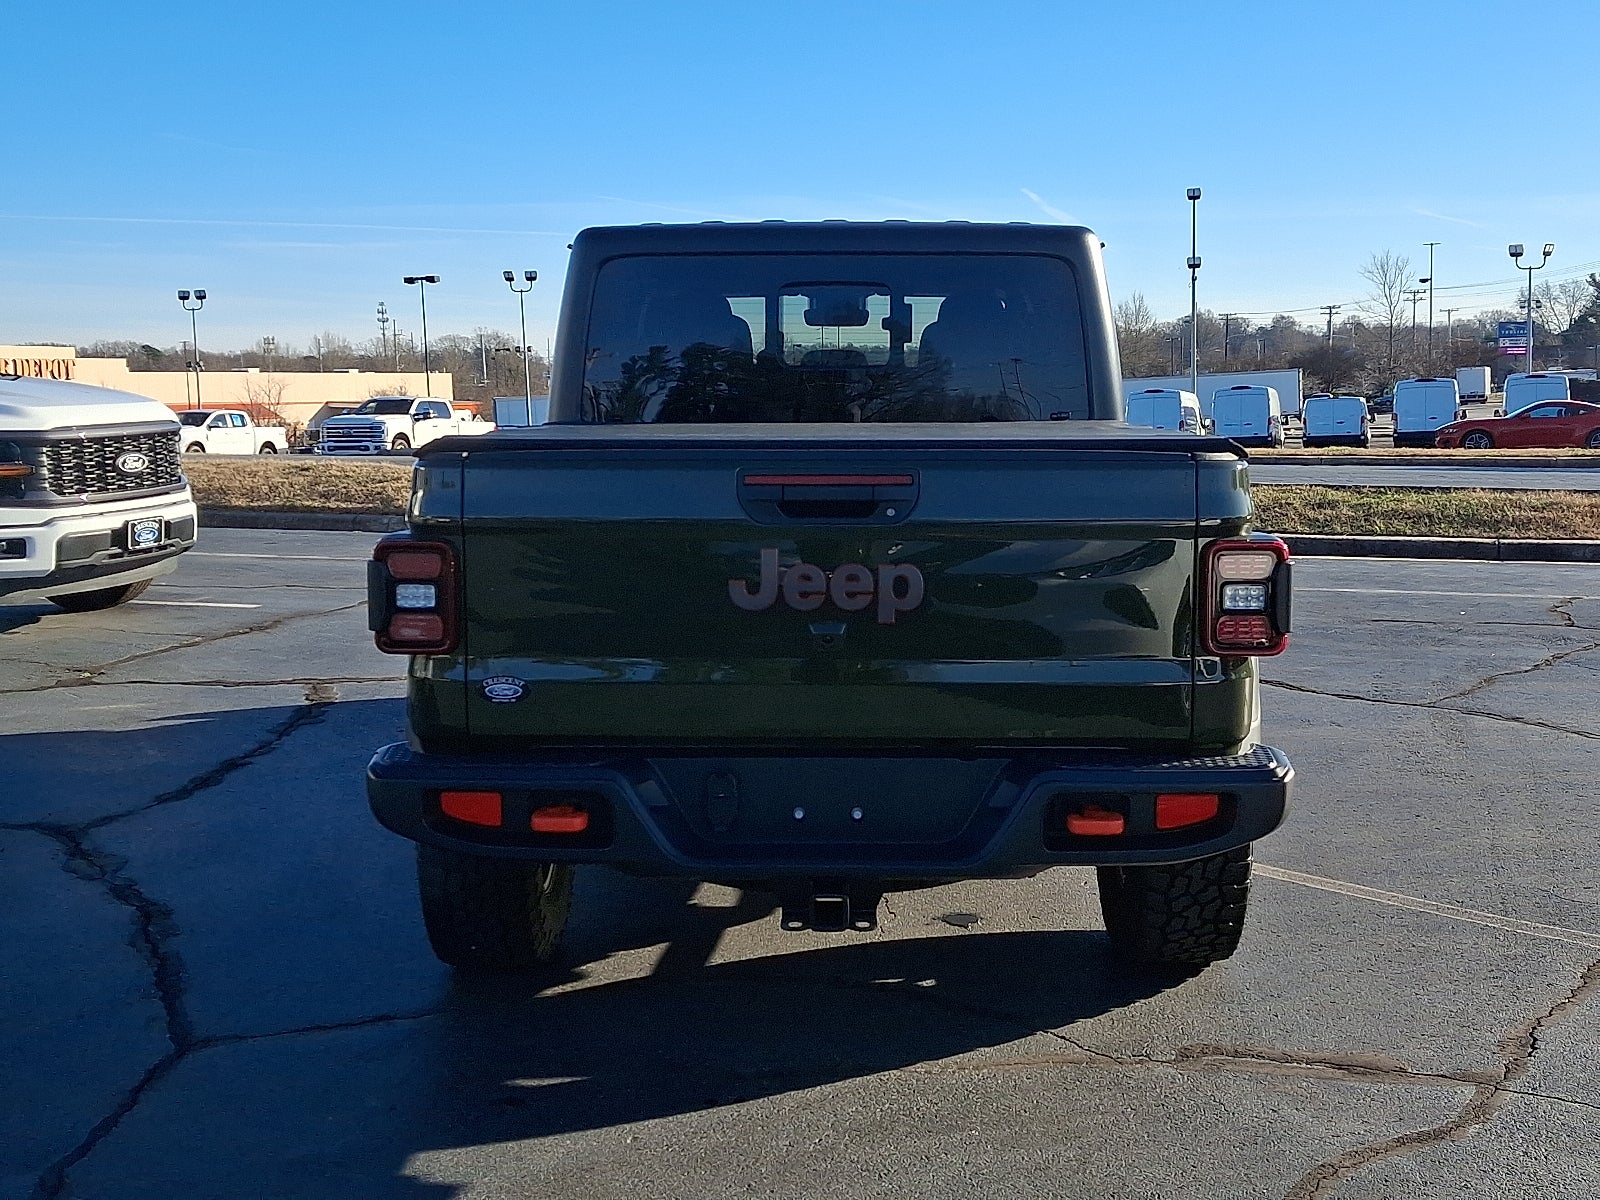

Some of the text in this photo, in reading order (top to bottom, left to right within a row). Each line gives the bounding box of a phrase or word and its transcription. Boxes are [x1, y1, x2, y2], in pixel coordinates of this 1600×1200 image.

[13, 358, 76, 380] DEPOT
[123, 456, 145, 470] Ford
[728, 548, 924, 624] Jeep
[482, 676, 526, 687] CRESCENT
